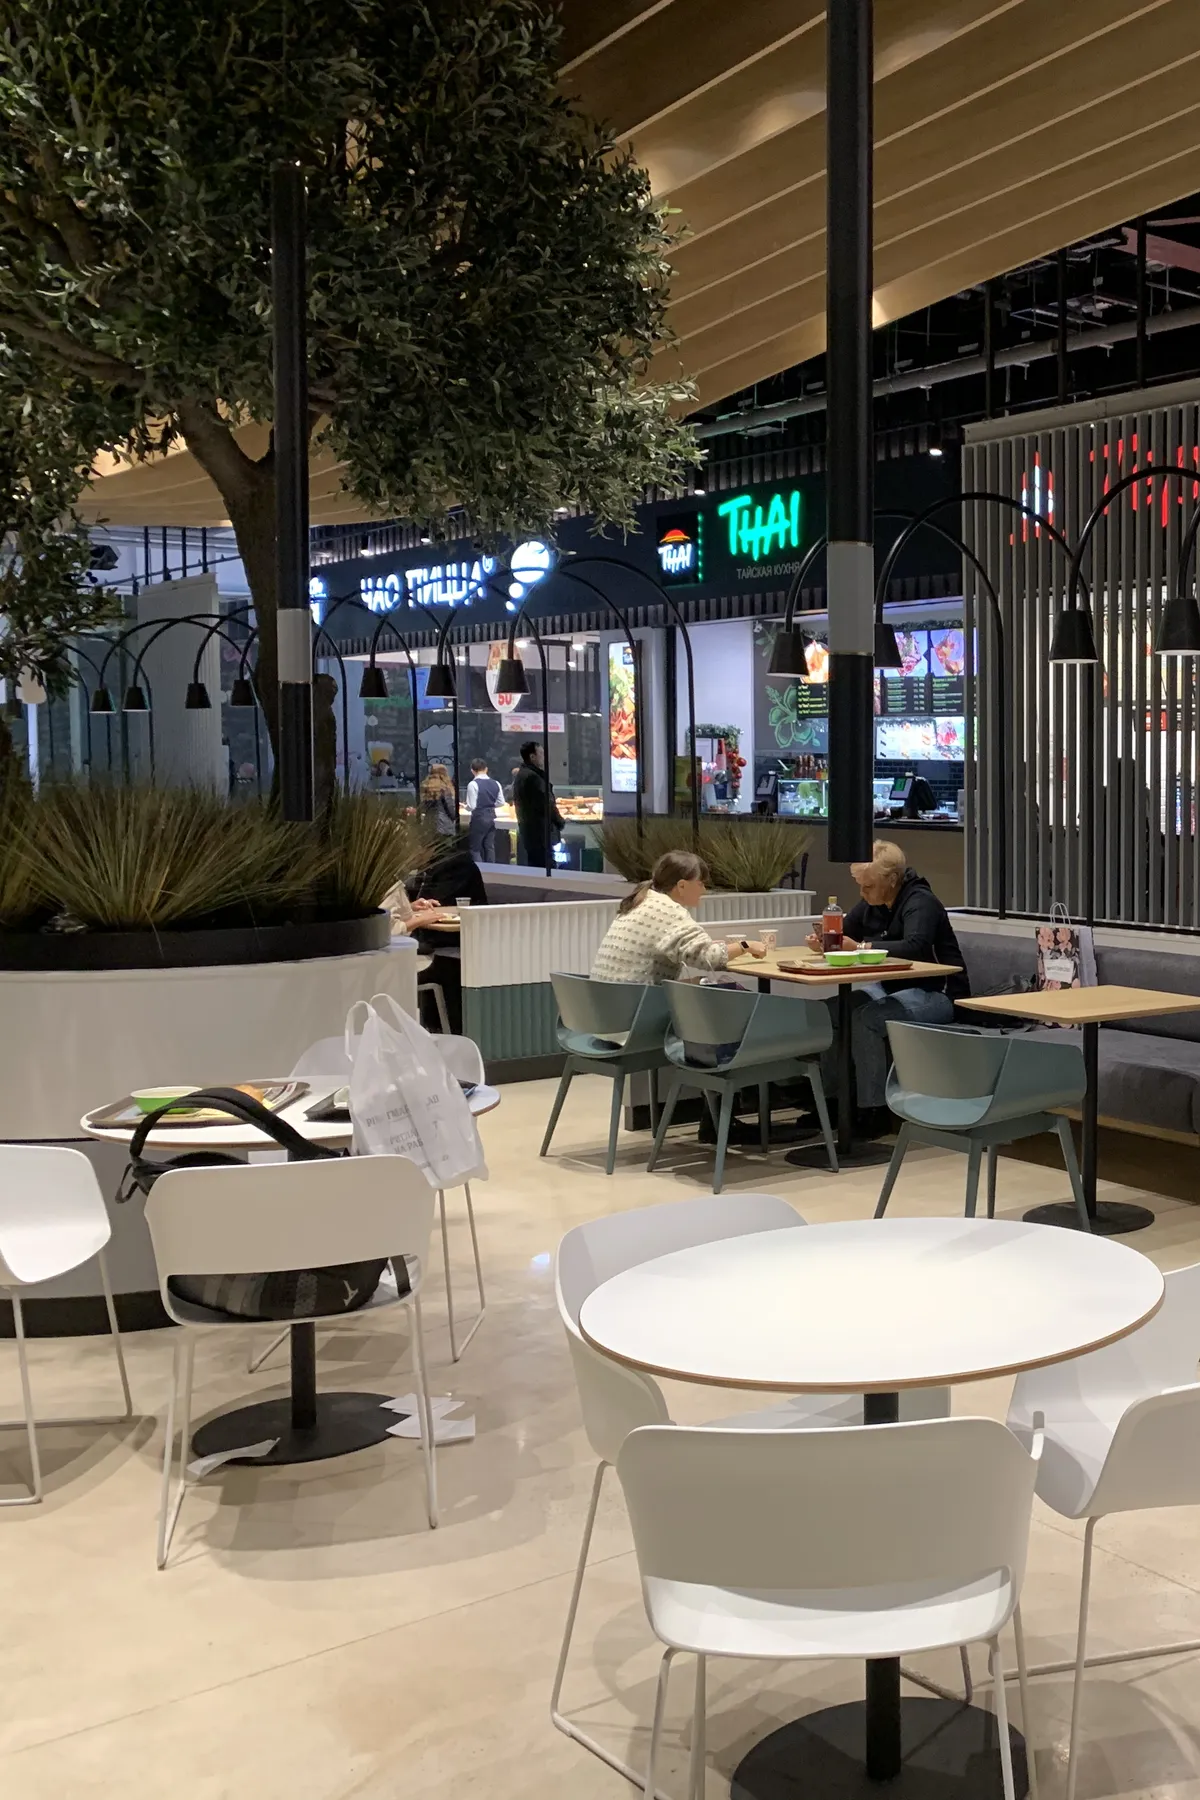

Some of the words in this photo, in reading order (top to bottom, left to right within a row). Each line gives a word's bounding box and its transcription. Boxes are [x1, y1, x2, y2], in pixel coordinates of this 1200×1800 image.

[717, 490, 801, 562] THAI
[657, 543, 692, 573] THAI
[737, 565, 773, 580] ТАЙСКАЯ
[774, 561, 801, 576] КУХНЯ
[360, 573, 400, 612] ЧАО
[405, 560, 484, 608] ПИЦЦА
